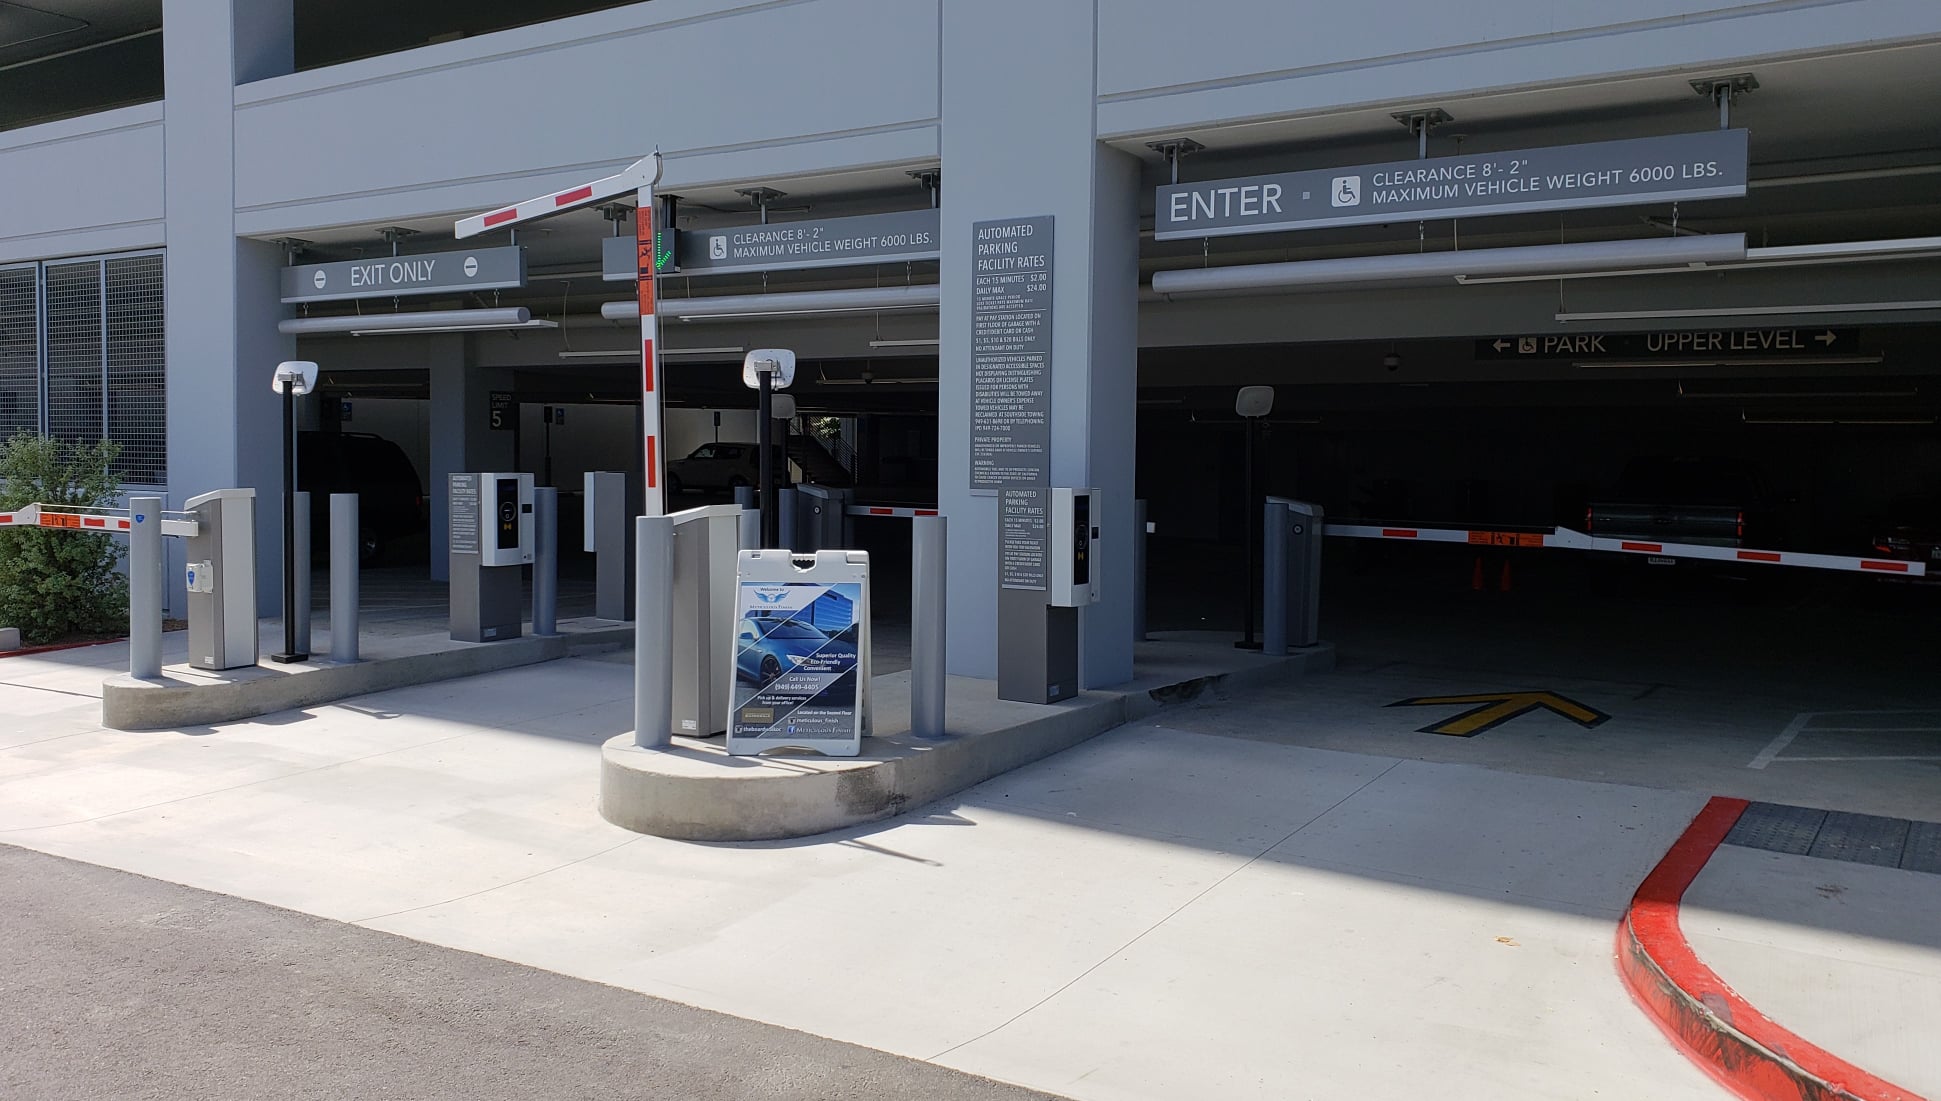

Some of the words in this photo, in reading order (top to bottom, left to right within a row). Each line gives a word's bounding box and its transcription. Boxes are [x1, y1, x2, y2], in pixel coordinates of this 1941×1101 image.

[1373, 165, 1476, 186] CLEARANCE
[1373, 183, 1459, 204] MAXIMUM
[1465, 177, 1540, 197] VEHICLE
[1546, 170, 1624, 190] WEIGHT
[1629, 165, 1675, 184] 6000
[1682, 161, 1724, 179] LBS.
[1170, 183, 1283, 222] ENTER
[733, 230, 794, 245] CLEARANCE
[978, 225, 1033, 240] AUTOMATED
[733, 244, 784, 258] MAXIMUM
[787, 240, 831, 254] VEHICLE
[834, 237, 877, 251] WEIGHT
[881, 234, 906, 247] 6000
[910, 232, 933, 245] LBS.
[978, 242, 1018, 256] PARKING
[978, 257, 1015, 271] FACILITY
[1018, 255, 1045, 268] RATES
[351, 264, 385, 287] EXIT
[389, 260, 436, 284] ONLY
[976, 277, 990, 285] EACH
[1000, 275, 1024, 283] MINUTES
[1030, 273, 1047, 282] $2.00
[976, 287, 991, 295] DAILY
[992, 286, 1005, 294] MAX
[1027, 284, 1047, 292] $24.00
[1545, 335, 1606, 354] PARK
[1647, 332, 1722, 351] UPPER
[1731, 330, 1805, 350] LEVEL
[492, 410, 502, 427] 5
[1006, 490, 1037, 498] AUTOMATED
[1006, 498, 1029, 506] PARKING
[1006, 506, 1027, 514] FACILITY
[1028, 507, 1044, 515] RATES
